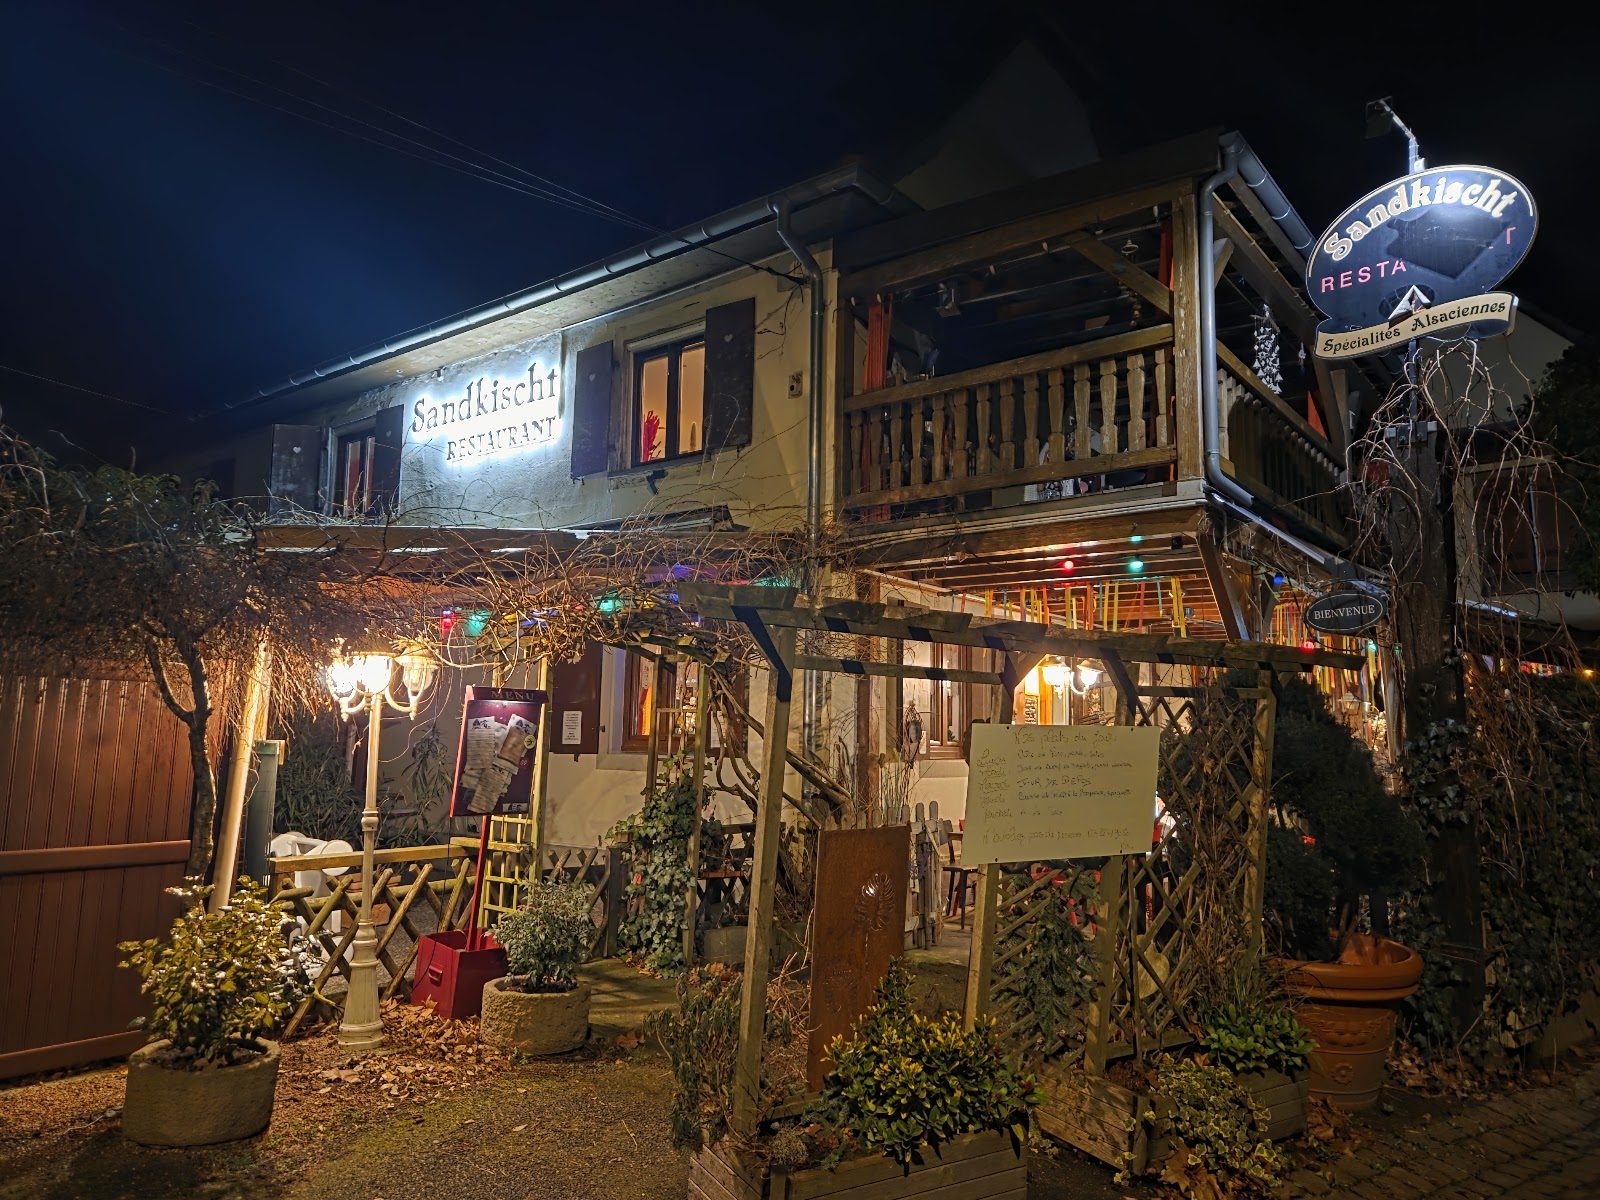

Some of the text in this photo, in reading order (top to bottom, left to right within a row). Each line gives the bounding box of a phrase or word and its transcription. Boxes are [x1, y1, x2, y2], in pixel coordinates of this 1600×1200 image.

[1324, 177, 1518, 261] Sandkischt
[1323, 300, 1507, 354] Spécialités Alsaciennes
[412, 362, 558, 432] Sandkischt
[447, 416, 556, 460] RESTAURANT
[1314, 605, 1375, 619] BIENVENUE
[491, 690, 533, 701] MENU
